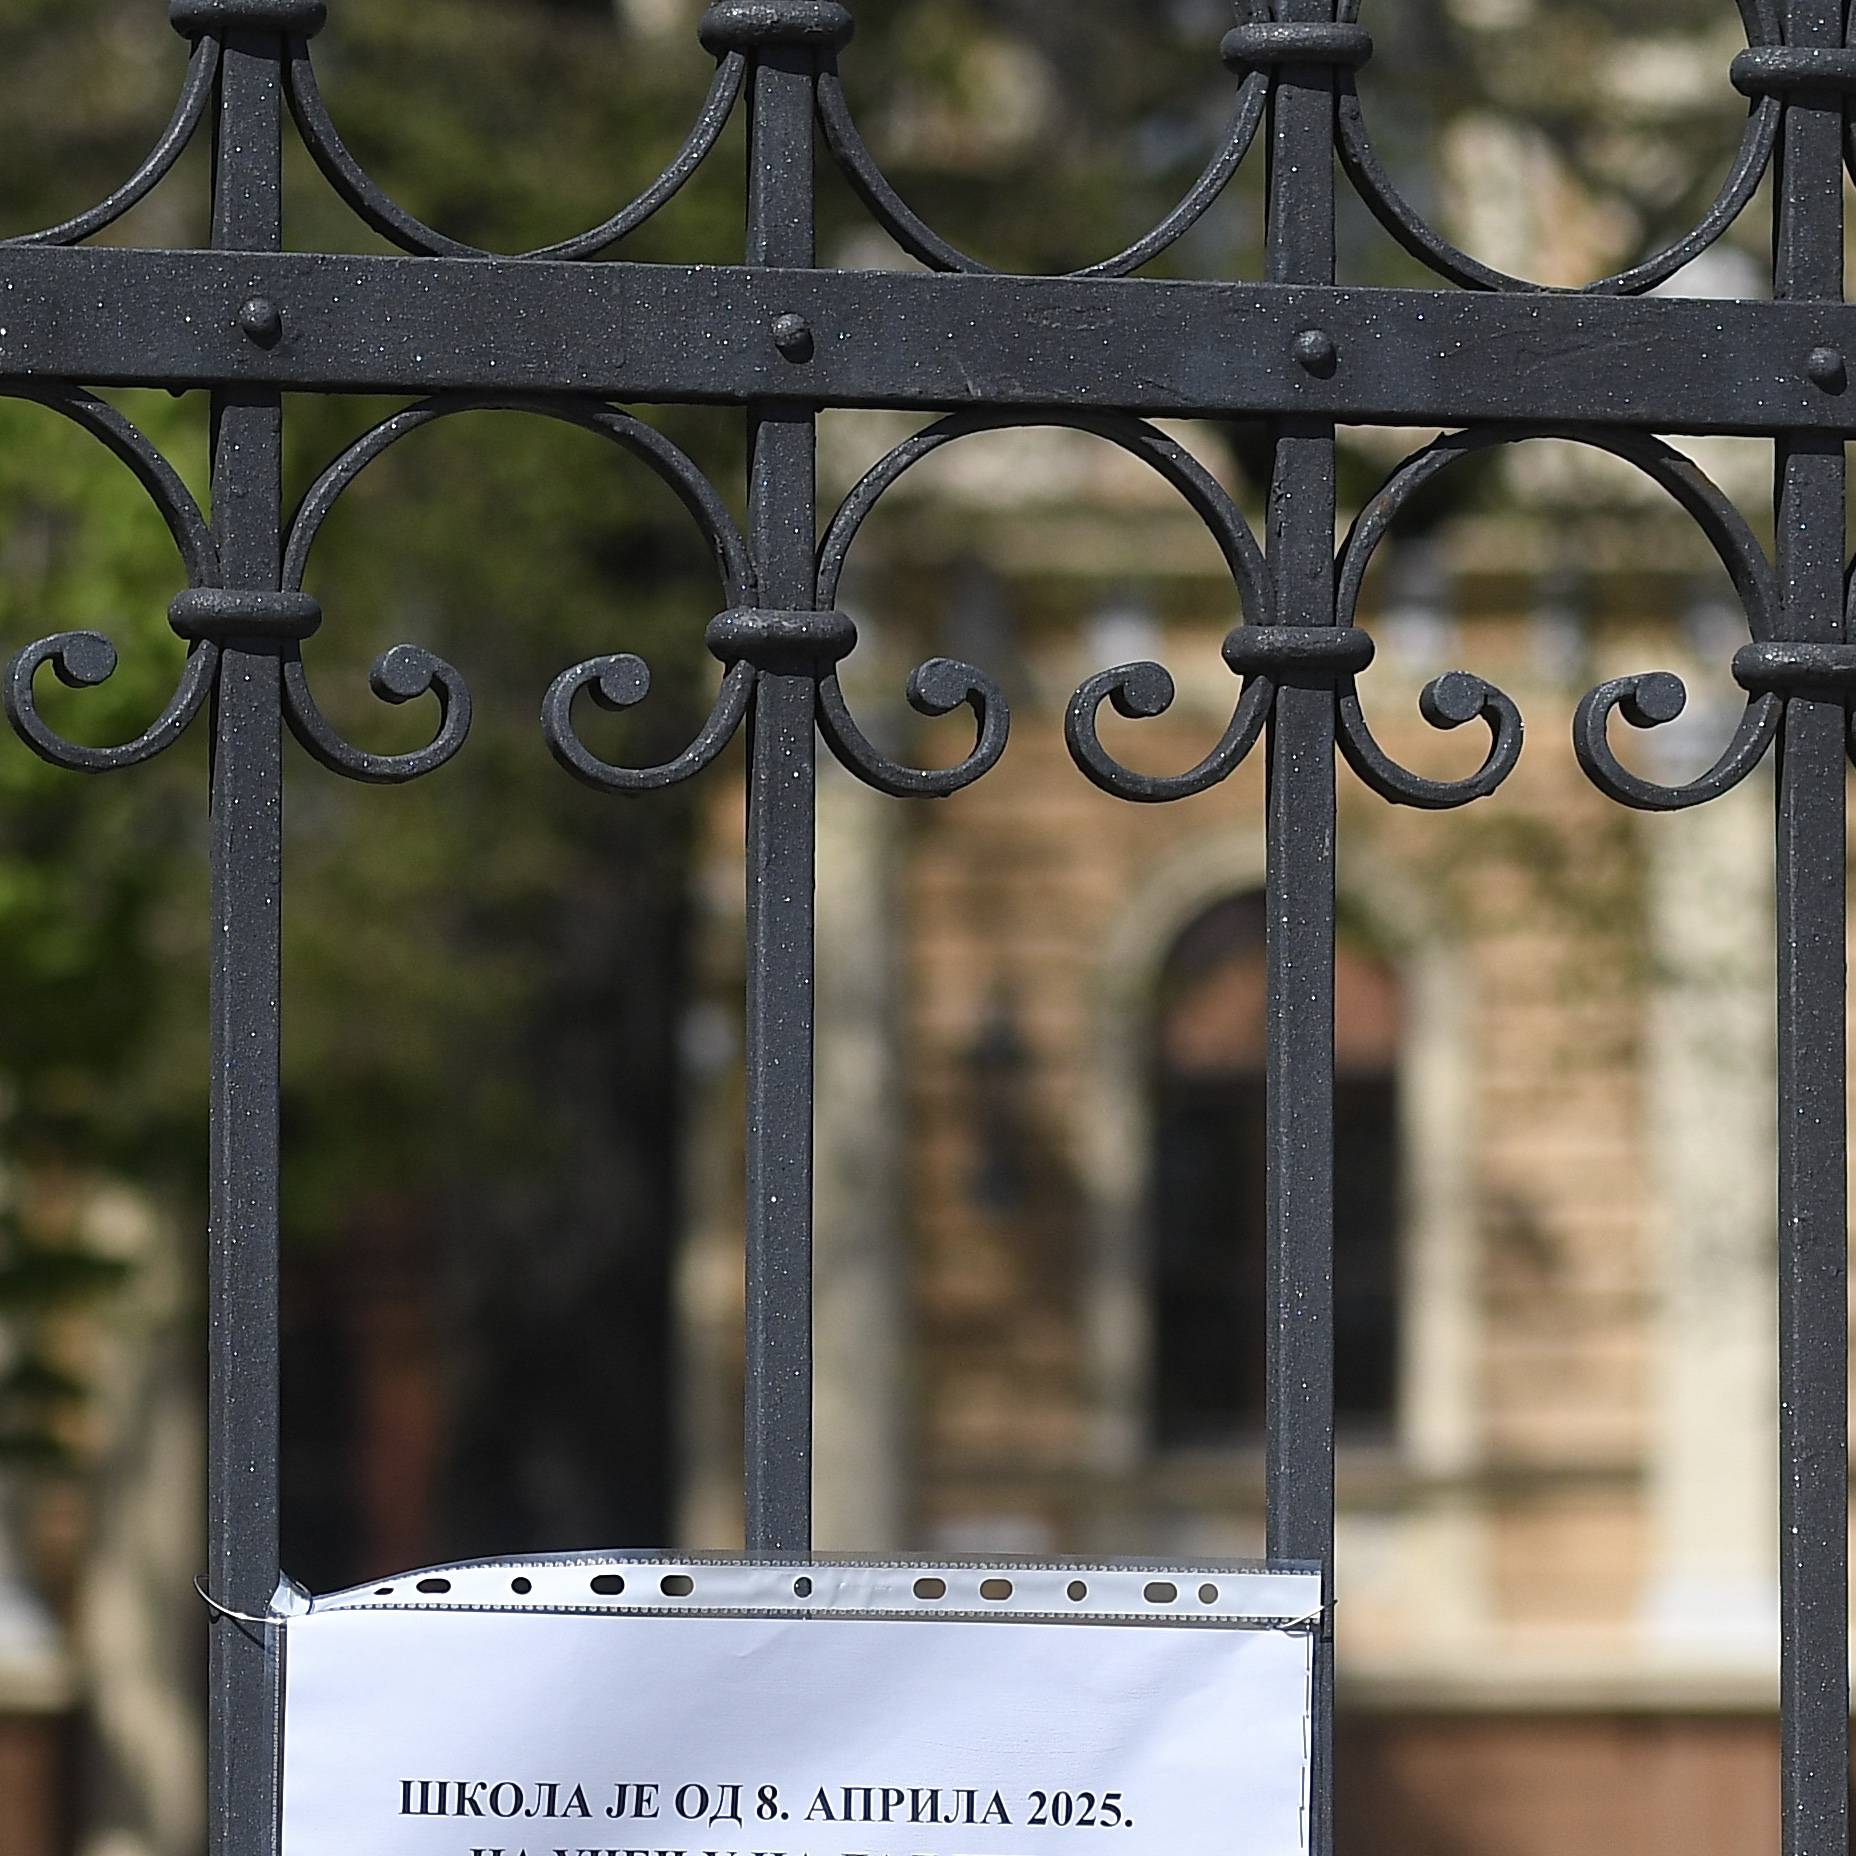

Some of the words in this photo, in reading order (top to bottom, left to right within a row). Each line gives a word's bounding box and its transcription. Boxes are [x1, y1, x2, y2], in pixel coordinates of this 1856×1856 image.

[399, 1780, 593, 1818] ШКОЛА
[606, 1783, 660, 1819] ЈЕ
[675, 1784, 744, 1828] ОД
[756, 1785, 789, 1821] 8.
[804, 1786, 1012, 1825] АПРИЛА
[1026, 1791, 1133, 1828] 2025.
